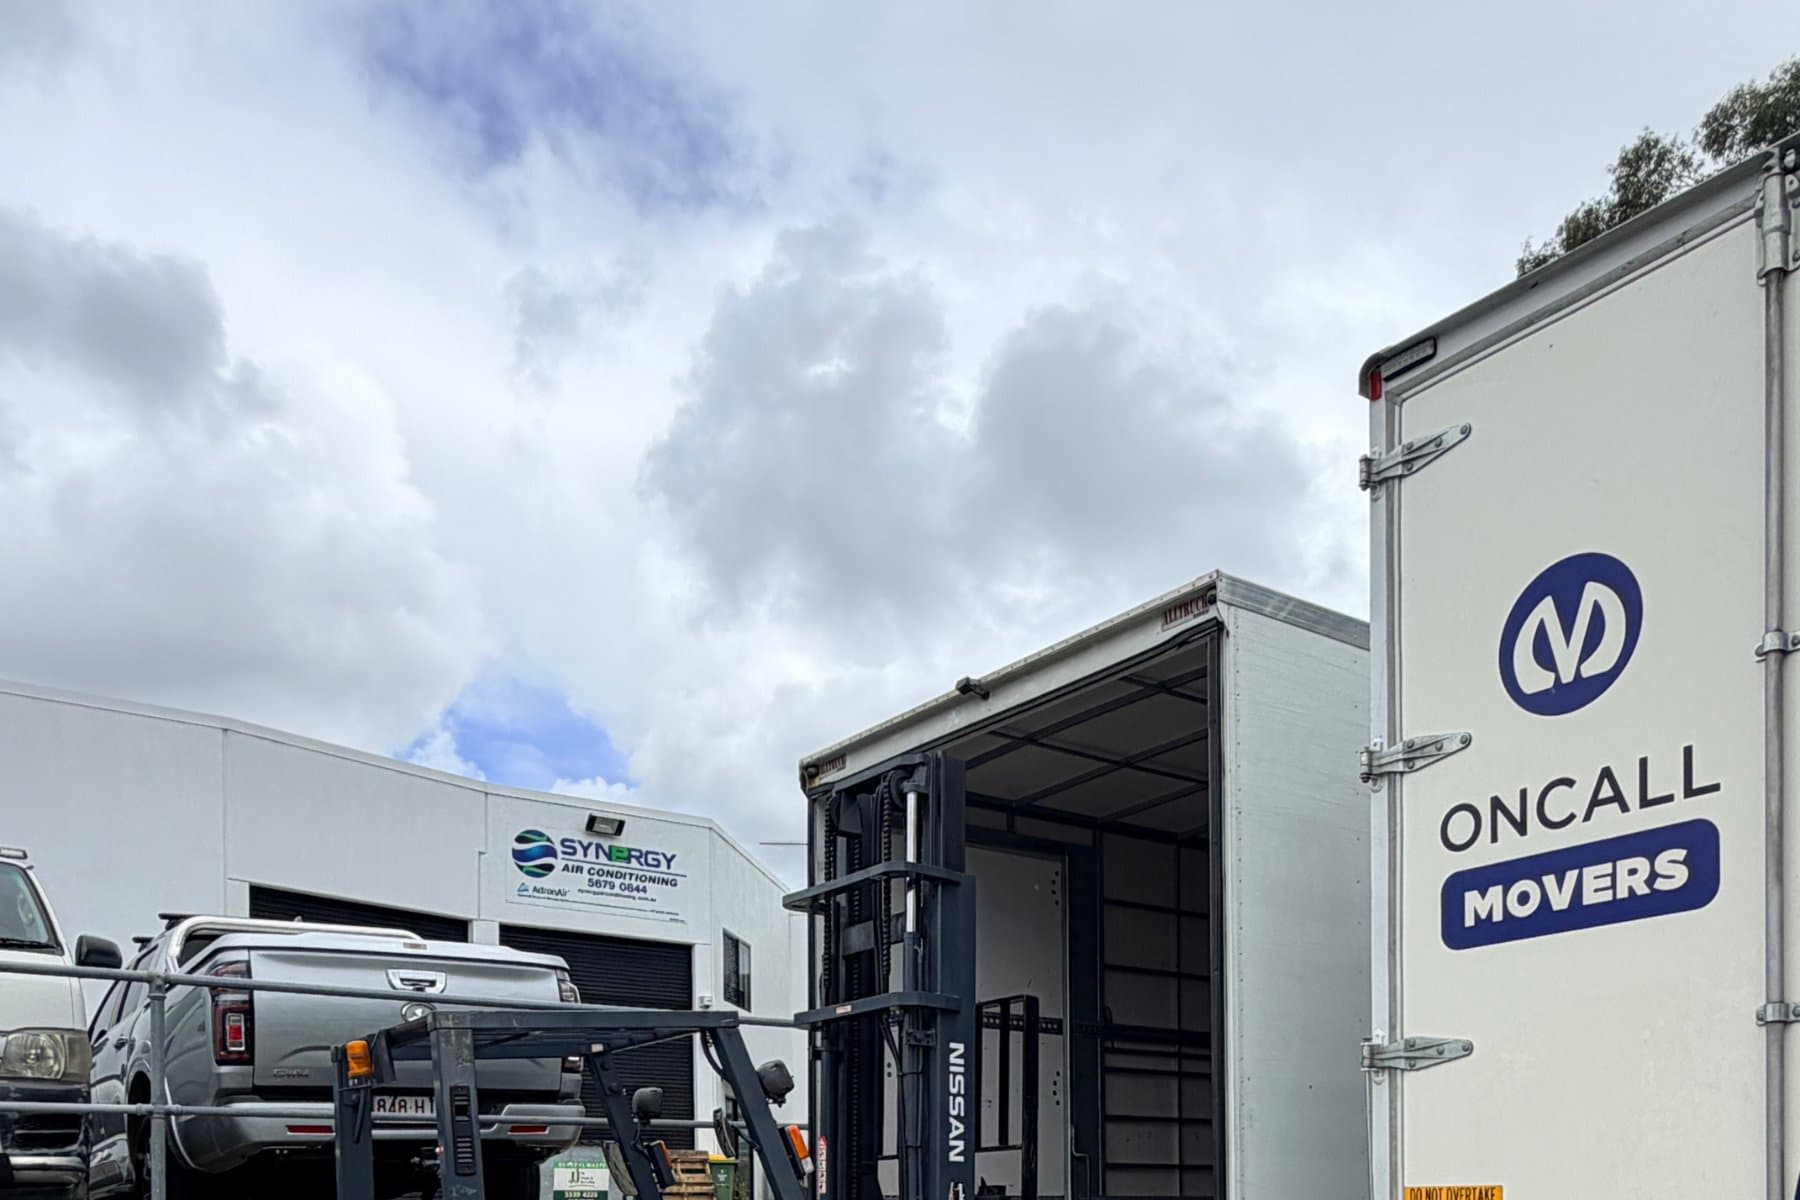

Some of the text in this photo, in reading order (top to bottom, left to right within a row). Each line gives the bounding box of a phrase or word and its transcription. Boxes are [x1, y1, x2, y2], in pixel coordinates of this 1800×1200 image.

[1440, 744, 1721, 853] ONCALL
[560, 837, 677, 870] SYNERGY
[561, 863, 678, 887] AIR CONDITIONING
[620, 882, 647, 895] 0844
[1463, 847, 1690, 928] MOVERS
[949, 1042, 965, 1163] NISSAN
